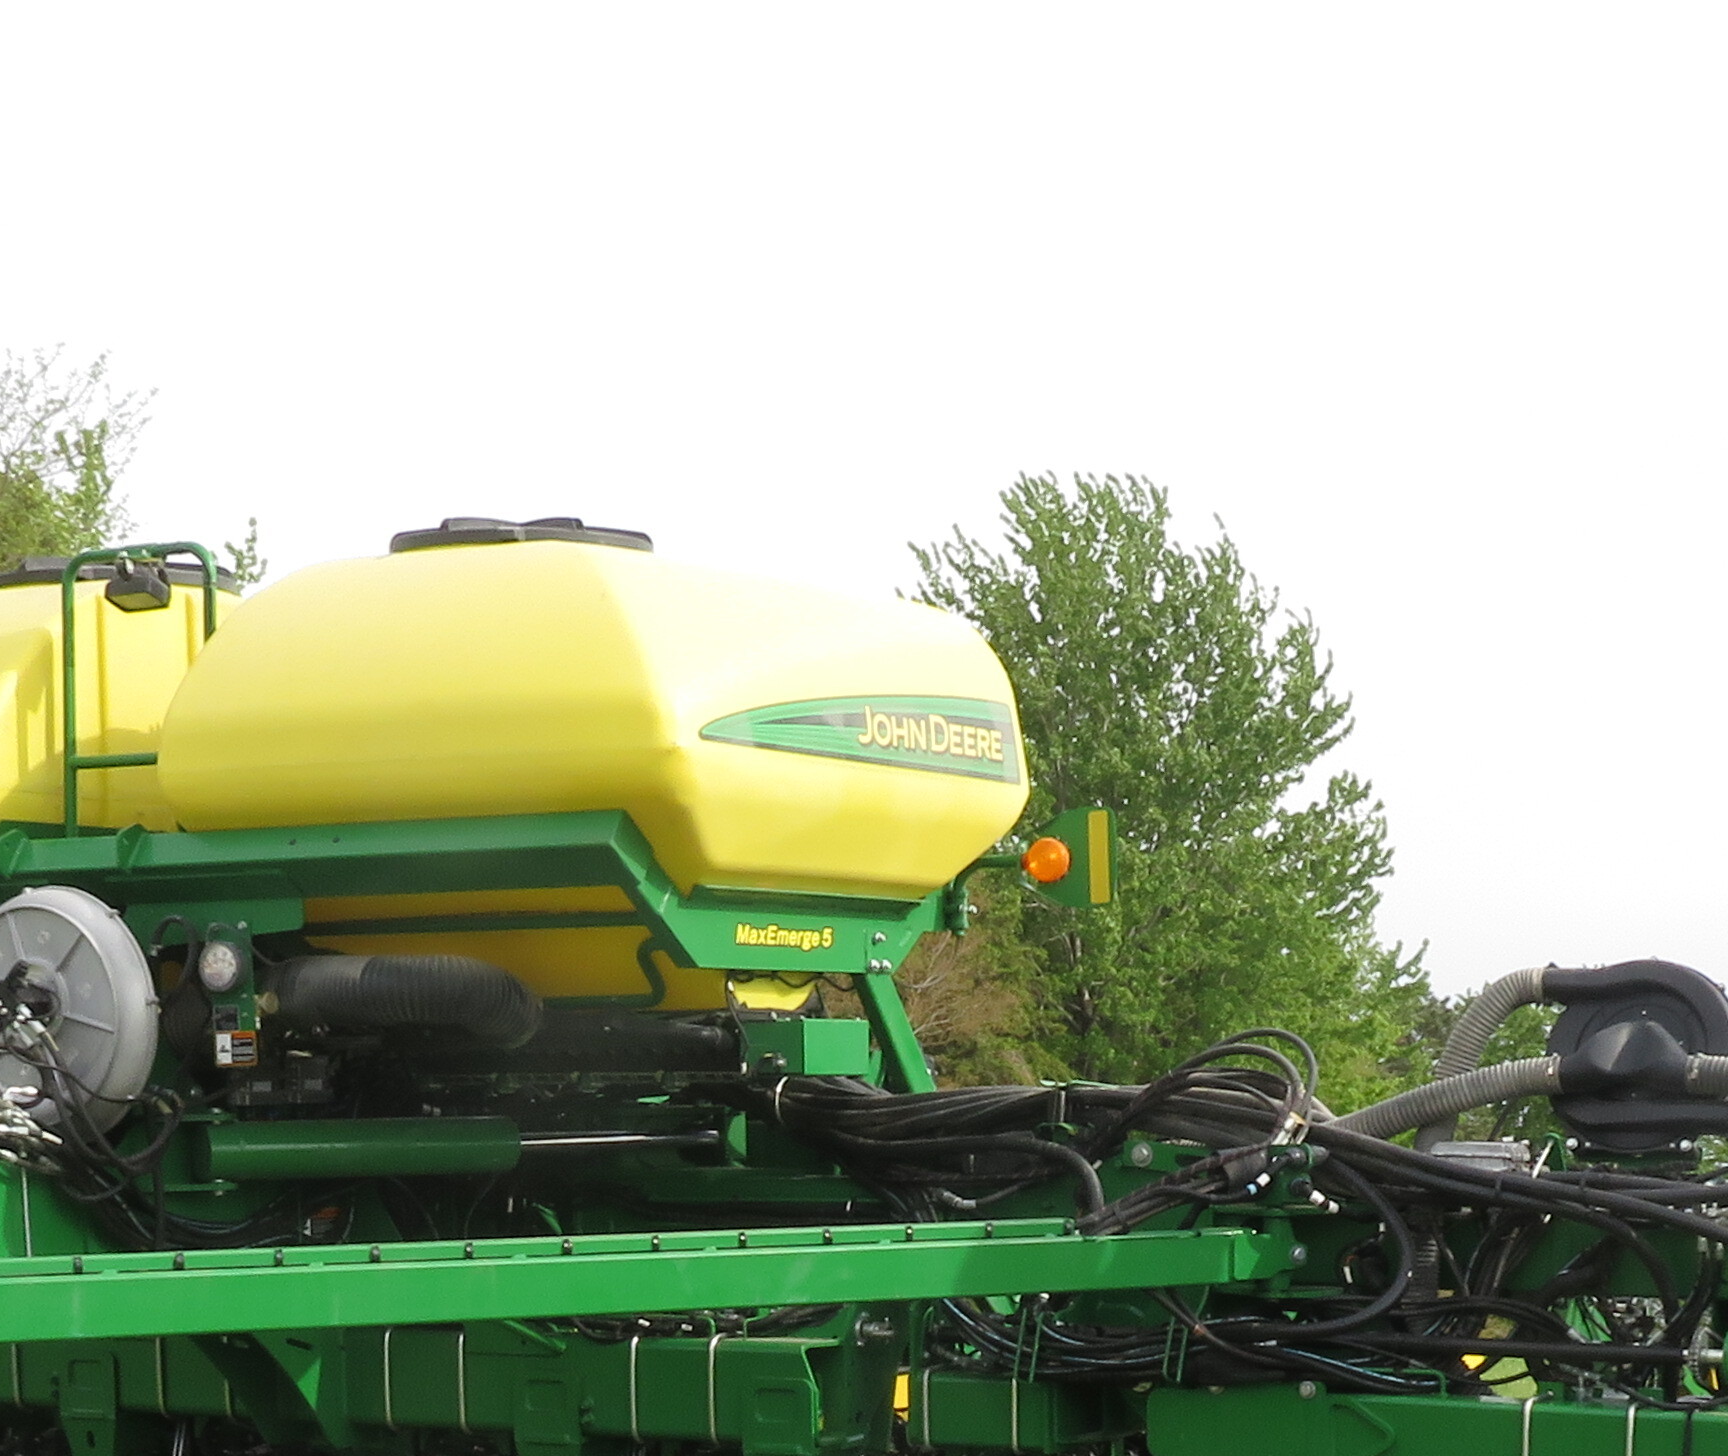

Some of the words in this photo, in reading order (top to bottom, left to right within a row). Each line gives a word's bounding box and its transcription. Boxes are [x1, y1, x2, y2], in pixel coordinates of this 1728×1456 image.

[858, 705, 927, 751] JOHN
[928, 713, 1003, 762] DEERE
[735, 923, 821, 951] MaxEmerge
[821, 926, 833, 949] 5
